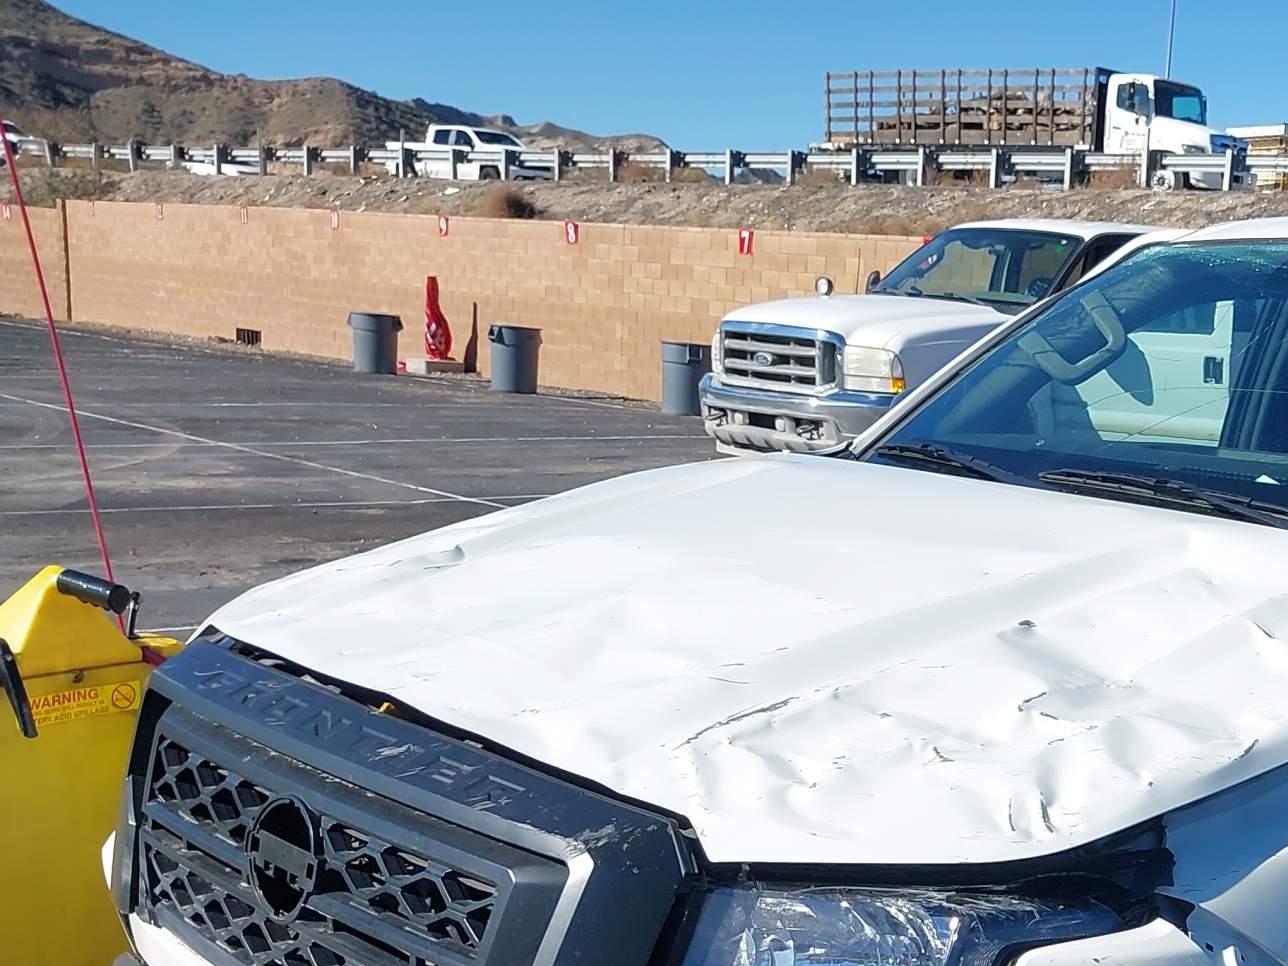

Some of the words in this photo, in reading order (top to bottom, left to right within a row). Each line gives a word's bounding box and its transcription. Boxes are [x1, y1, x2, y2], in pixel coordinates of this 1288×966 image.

[440, 216, 447, 235] 9
[567, 223, 576, 243] 8
[741, 230, 750, 254] 7
[31, 688, 99, 711] WARNING
[54, 713, 72, 722] ACID
